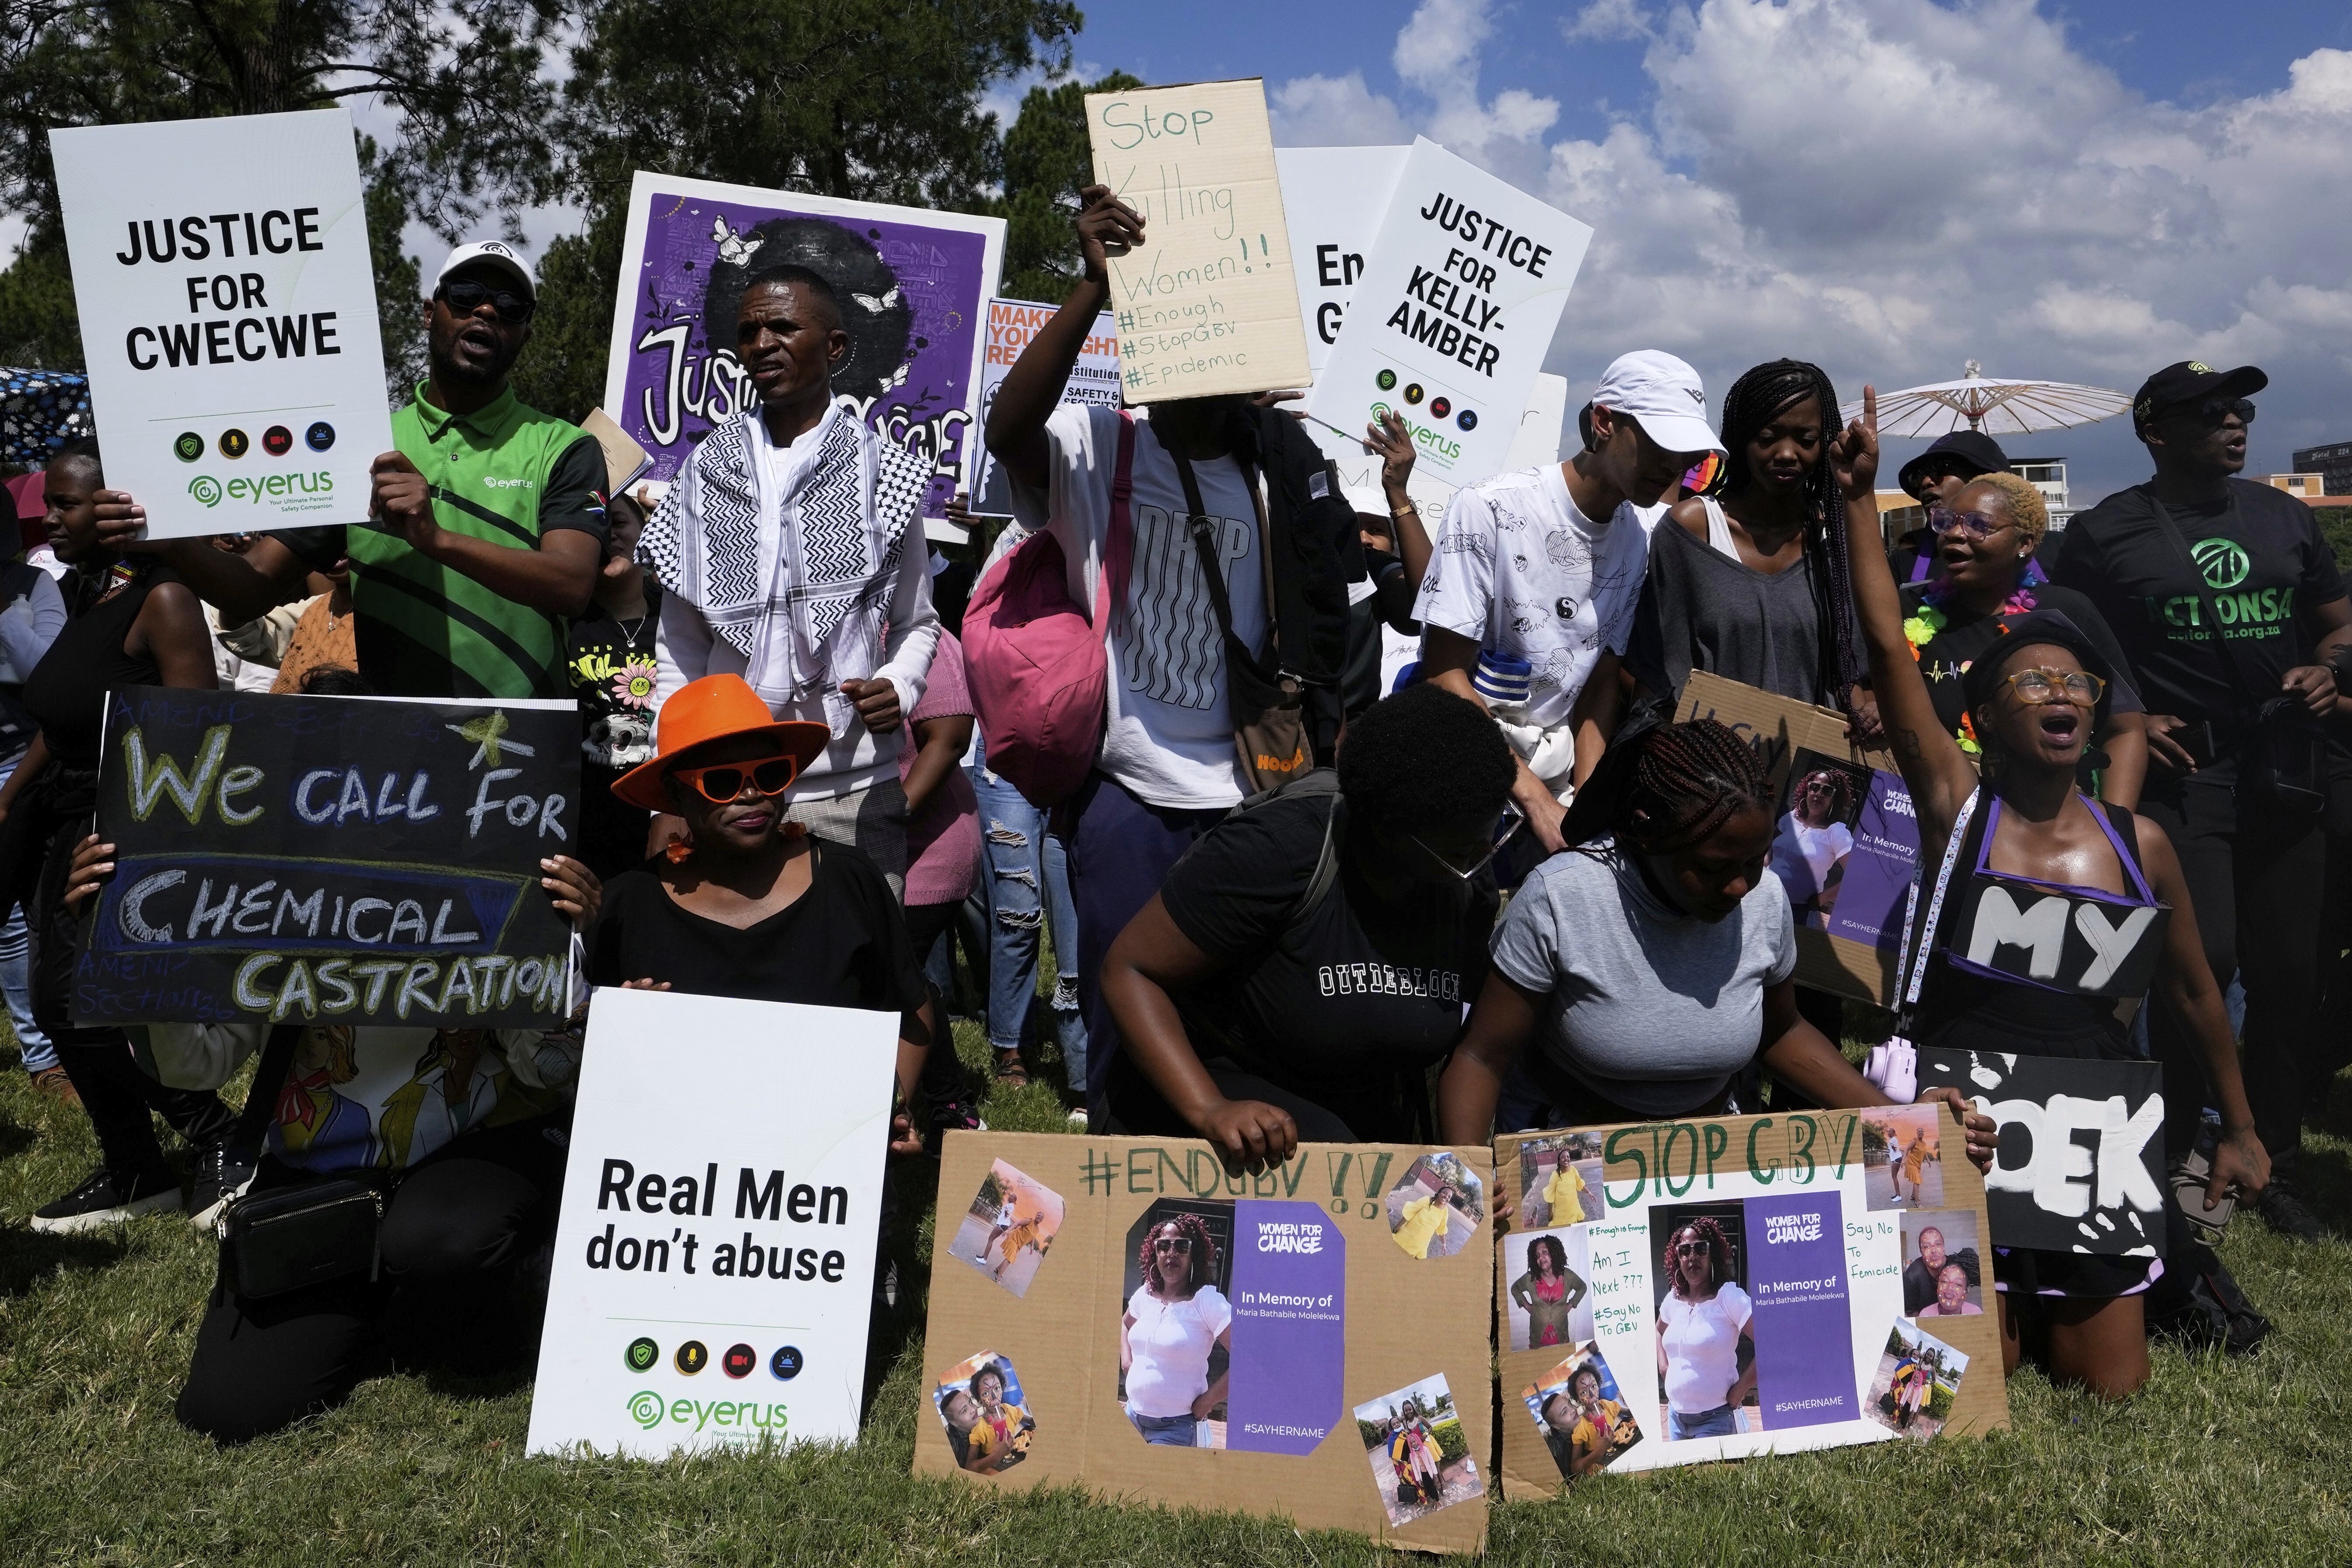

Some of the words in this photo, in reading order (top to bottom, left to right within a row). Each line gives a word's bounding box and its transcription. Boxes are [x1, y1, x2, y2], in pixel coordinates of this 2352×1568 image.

[1103, 103, 1213, 149] Stop
[1104, 161, 1233, 240] Killing
[116, 207, 323, 265] JUSTICE
[1421, 192, 1552, 279] JUSTICE
[1112, 234, 1271, 301] Women!!
[1316, 244, 1364, 286] En
[1443, 247, 1496, 293] FOR
[187, 273, 268, 313] FOR
[1406, 265, 1504, 332] KELLY-
[1118, 294, 1224, 333] #Enough
[126, 312, 341, 370] CWECWE
[989, 324, 1040, 347] YOU
[1121, 321, 1235, 359] #StopGBV
[1386, 301, 1500, 377] AMBER
[1070, 366, 1120, 380] stitution
[1125, 353, 1246, 389] #Epidemic
[1068, 387, 1110, 399] SAFETY
[1111, 392, 1119, 401] &
[2135, 404, 2144, 416] ACT
[2144, 397, 2151, 408] AS
[2140, 407, 2151, 421] ONE
[1419, 452, 1430, 461] Safety
[1423, 448, 1439, 458] Ultimate
[1439, 455, 1455, 466] Personal
[227, 471, 333, 504] eyerus
[498, 479, 533, 489] eyerus
[2145, 587, 2295, 626] ACTONSA
[2167, 625, 2281, 640] actiona.org.za
[122, 723, 265, 827] We
[292, 765, 441, 826] CALL
[465, 767, 568, 843] FOR
[1887, 789, 1912, 803] WOME
[1884, 799, 1917, 819] CHAN
[1856, 843, 1872, 852] Maria
[1873, 847, 1899, 860] Bathabile
[1900, 855, 1916, 865] Molel
[1862, 832, 1871, 843] In
[1874, 836, 1915, 856] Memory
[119, 870, 480, 944] CHEMICAL
[1842, 919, 1899, 941] #SAYHERNAME
[1967, 885, 2158, 991] MY
[231, 951, 570, 1022] CASTRATION
[1603, 1123, 1728, 1209] STOP
[1747, 1115, 1857, 1185] GBV
[1969, 1092, 2164, 1218] OEK
[597, 1158, 718, 1216] Real
[735, 1167, 848, 1225] Men
[1258, 1223, 1298, 1236] WOMEN
[1300, 1224, 1323, 1237] FOR
[1765, 1215, 1801, 1228] WOMEN
[1802, 1213, 1821, 1224] FOR
[1846, 1223, 1873, 1240] Say
[1878, 1222, 1893, 1235] No
[1258, 1235, 1323, 1254] CHANGE
[1767, 1224, 1823, 1244] CHANGE
[586, 1223, 698, 1274] don't
[712, 1232, 845, 1283] abuse
[1593, 1251, 1612, 1271] Am
[1616, 1251, 1631, 1266] I
[1847, 1246, 1861, 1258] To
[1851, 1264, 1899, 1279] Femicide
[1592, 1277, 1619, 1297] Next
[1759, 1283, 1770, 1294] In
[1773, 1279, 1822, 1292] Memory
[1824, 1275, 1836, 1288] of
[1242, 1291, 1254, 1303] In
[1259, 1292, 1315, 1309] Memory
[1318, 1295, 1333, 1307] of
[1776, 1295, 1808, 1305] Bathabile
[1808, 1291, 1845, 1301] Molelekwa
[1237, 1308, 1258, 1317] Maria
[1260, 1309, 1297, 1318] Bathabile
[1298, 1311, 1340, 1321] Molelekwa
[1594, 1307, 1626, 1321] #Say
[1628, 1303, 1640, 1314] No
[1598, 1324, 1612, 1336] To
[1616, 1322, 1637, 1335] GBV
[1776, 1396, 1843, 1412] #SAYHERNAME
[670, 1399, 788, 1432] eyerus
[1244, 1423, 1325, 1439] #SAYHERNAME
